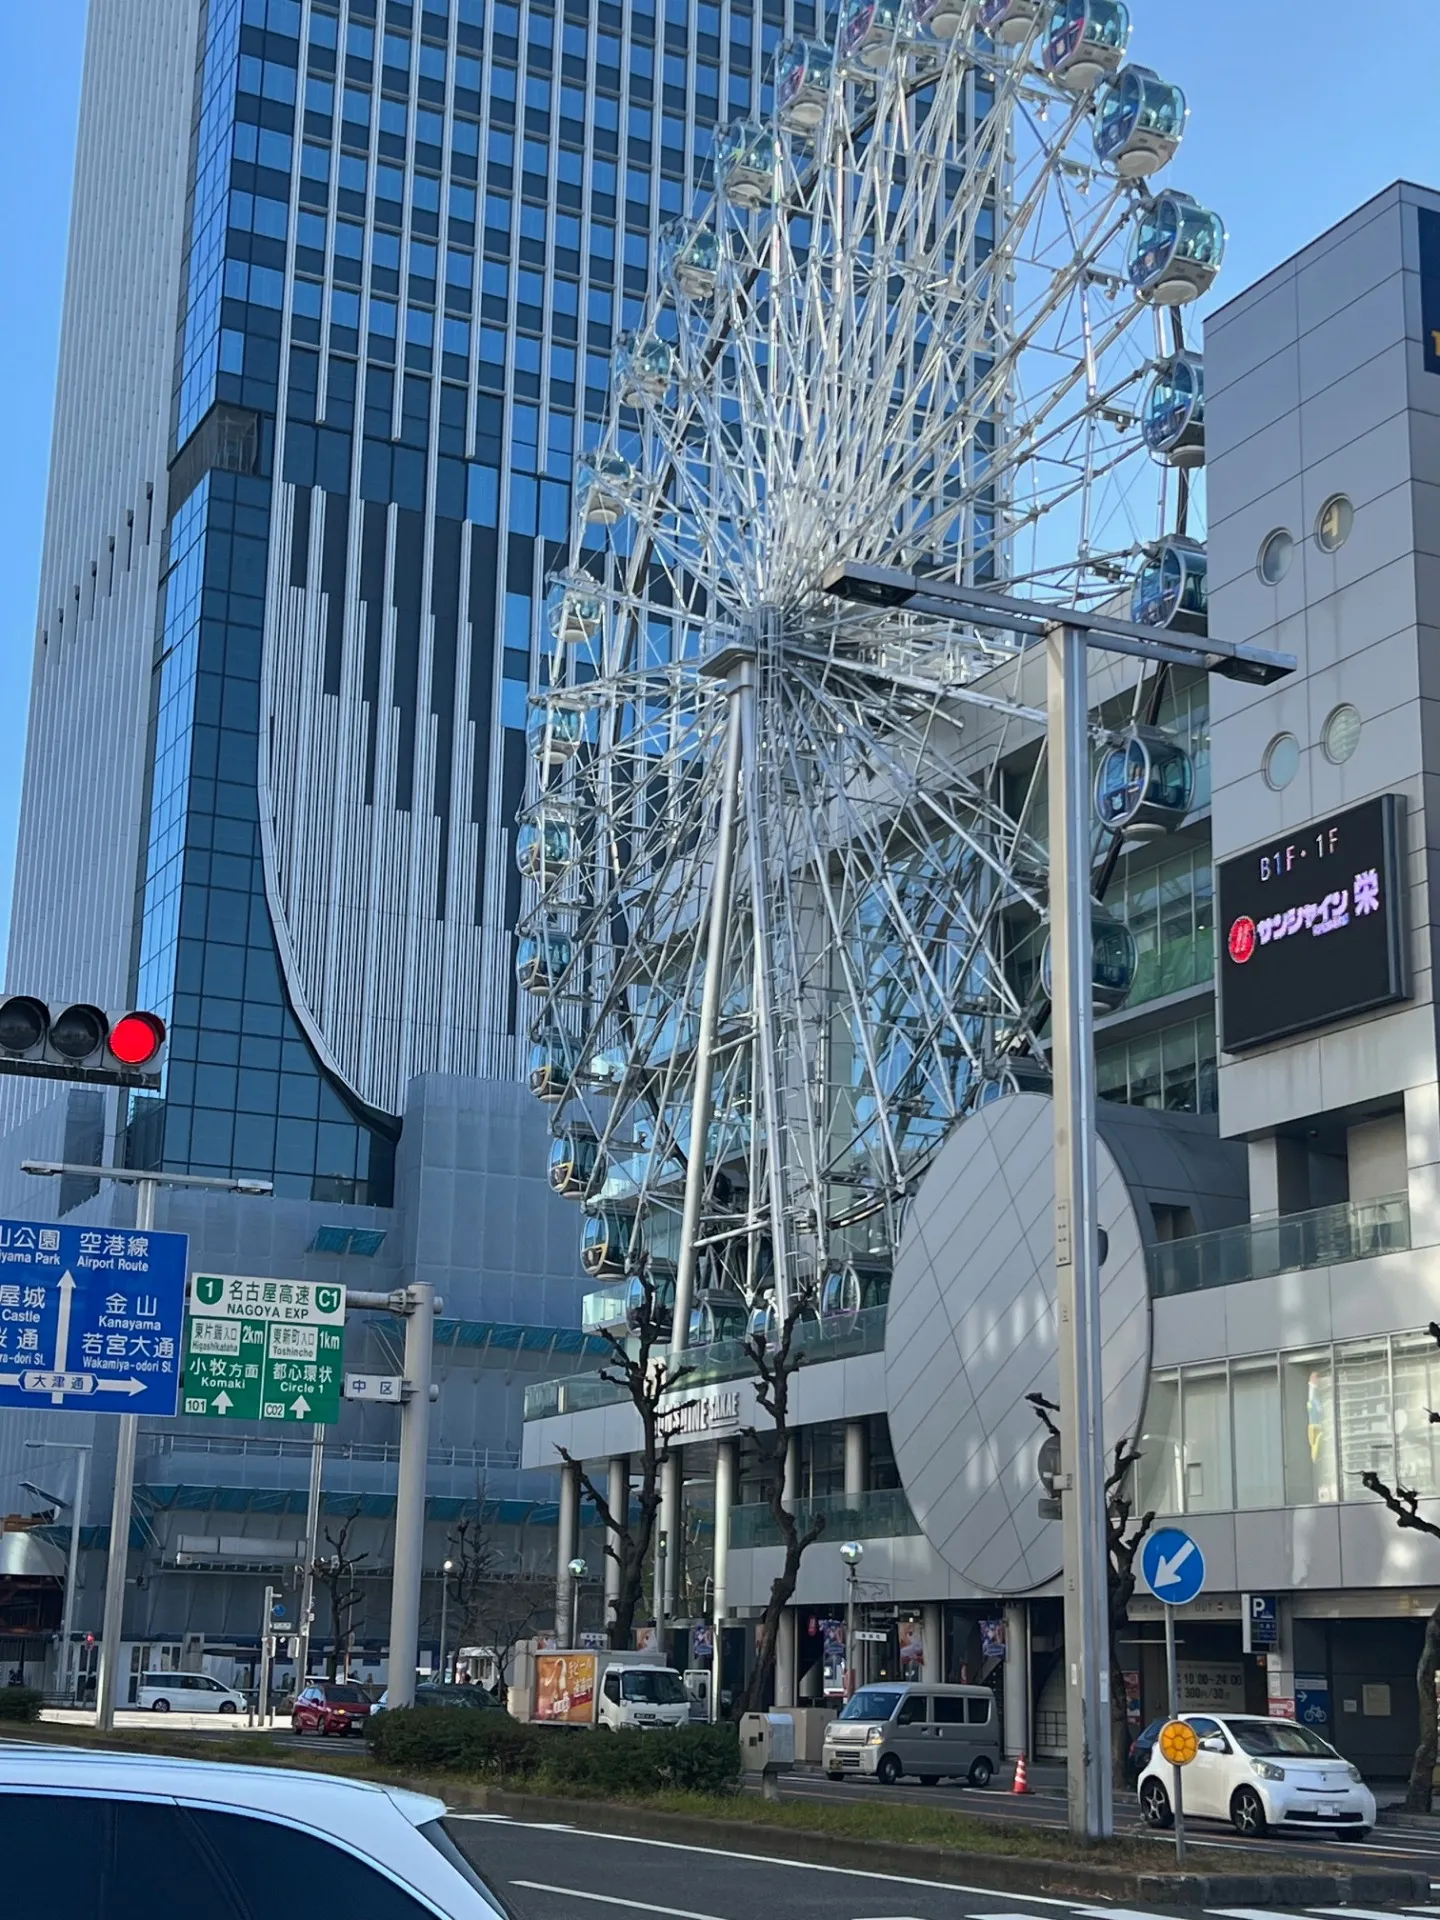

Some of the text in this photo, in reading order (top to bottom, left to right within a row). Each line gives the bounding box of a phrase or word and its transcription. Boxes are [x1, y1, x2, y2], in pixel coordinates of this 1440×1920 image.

[79, 1231, 149, 1258] 空港線
[35, 1251, 61, 1266] Park
[77, 1255, 149, 1273] Airport Route
[228, 1279, 310, 1306] 名古屋高速
[318, 1289, 338, 1308] C1
[105, 1292, 157, 1317] 金山
[227, 1303, 309, 1320] NAGOYA EXP
[1, 1308, 41, 1323] Castle
[98, 1315, 162, 1331] Kanayama
[242, 1325, 264, 1345] 2km
[319, 1331, 340, 1350] 1km
[81, 1332, 174, 1359] 若宮大通
[34, 1352, 46, 1366] St.
[82, 1355, 174, 1374] Wakamiya-odori St.
[189, 1357, 259, 1379] 小牧方面
[273, 1362, 333, 1383] 都心環状
[32, 1375, 84, 1390] 大津通
[201, 1376, 246, 1389] Komaki
[280, 1381, 324, 1394] Circle 1
[352, 1379, 393, 1394] 中区
[187, 1399, 205, 1412] 101
[266, 1404, 284, 1416] C02
[653, 1391, 739, 1438] UNSHINE SAKAE
